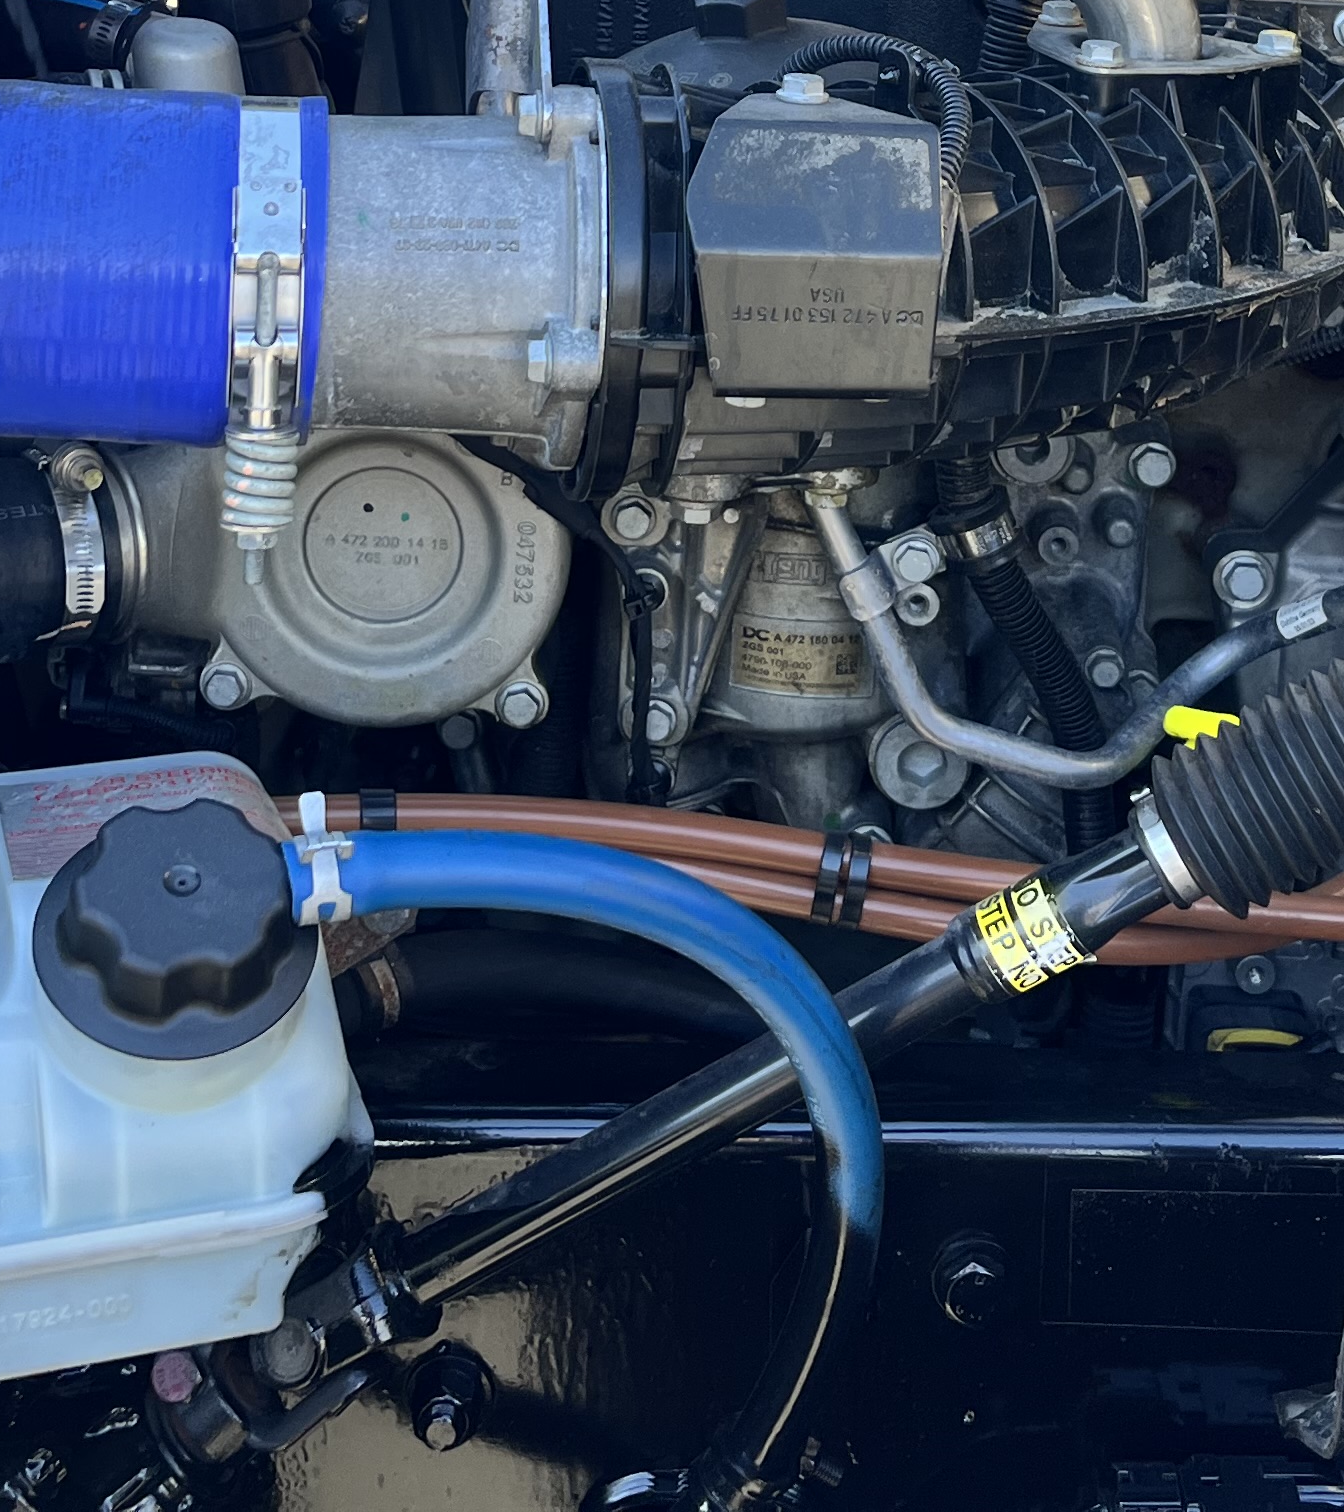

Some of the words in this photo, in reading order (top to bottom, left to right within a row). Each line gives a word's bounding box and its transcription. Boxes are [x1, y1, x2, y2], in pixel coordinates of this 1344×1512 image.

[811, 288, 844, 303] USA
[808, 308, 835, 323] 153
[341, 534, 367, 547] 472
[408, 538, 424, 549] 14
[513, 520, 537, 604] 047532
[743, 626, 771, 642] DC
[774, 633, 784, 642] A
[785, 634, 805, 644] 472
[767, 646, 784, 655] 001
[742, 663, 769, 676] Made
[785, 671, 806, 680] USA
[978, 894, 1016, 950] STEP
